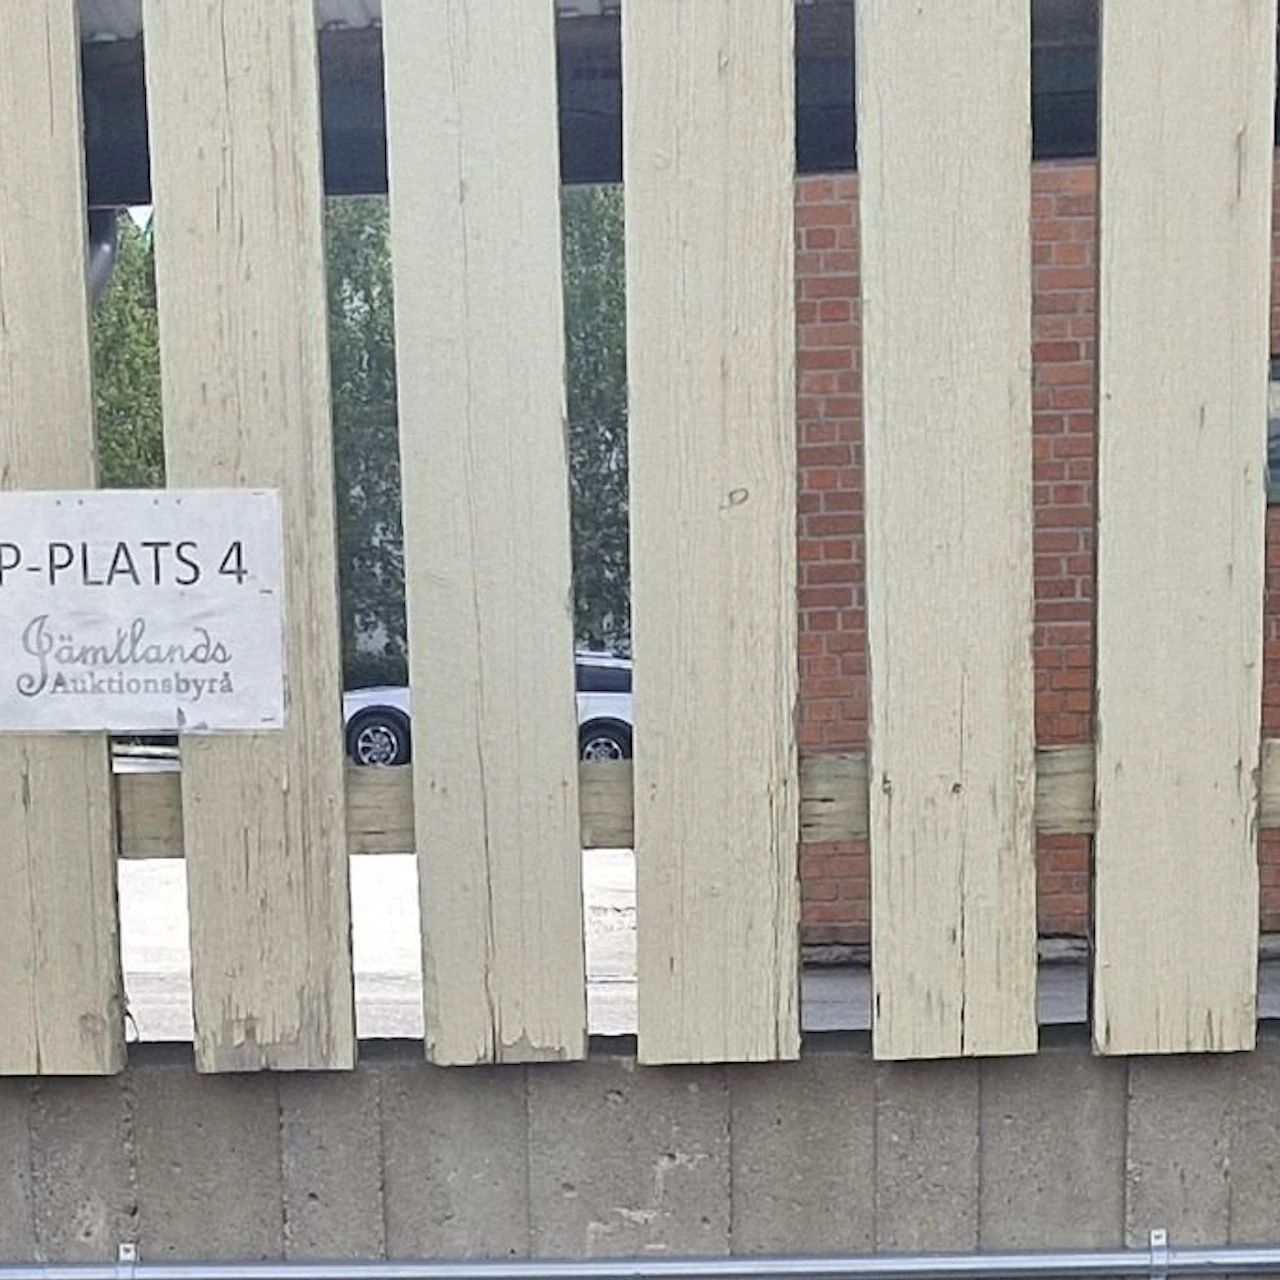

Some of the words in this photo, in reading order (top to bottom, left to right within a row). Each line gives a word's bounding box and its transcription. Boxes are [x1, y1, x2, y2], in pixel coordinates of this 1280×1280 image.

[219, 541, 248, 585] 4
[17, 614, 232, 696] Jämtlands
[50, 671, 234, 701] Auktionsbyrå
